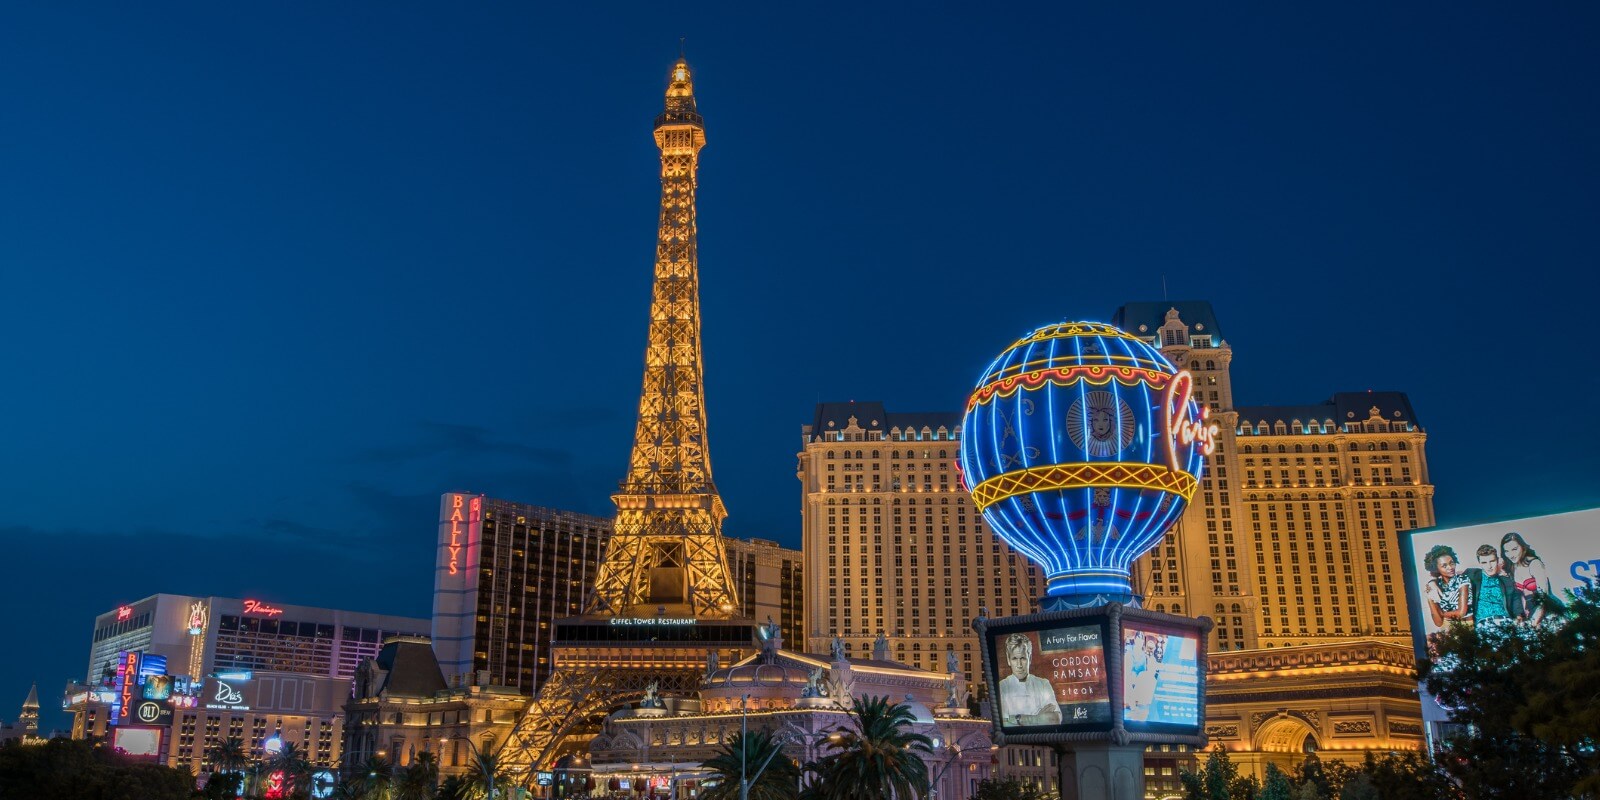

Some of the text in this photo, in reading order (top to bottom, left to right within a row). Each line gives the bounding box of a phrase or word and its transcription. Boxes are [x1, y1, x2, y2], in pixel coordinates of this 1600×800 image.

[1166, 370, 1218, 472] Paris
[243, 600, 283, 617] Flamingo
[610, 617, 632, 625] EIFFEL
[633, 617, 656, 625] TOWER
[1052, 636, 1065, 644] Fury
[1066, 634, 1077, 643] For
[1078, 633, 1098, 641] Flavor
[1052, 655, 1098, 668] GORDON
[1053, 667, 1099, 679] RAMSAY
[120, 653, 136, 717] BALLYS
[1062, 686, 1094, 696] steak
[143, 706, 156, 718] BLT
